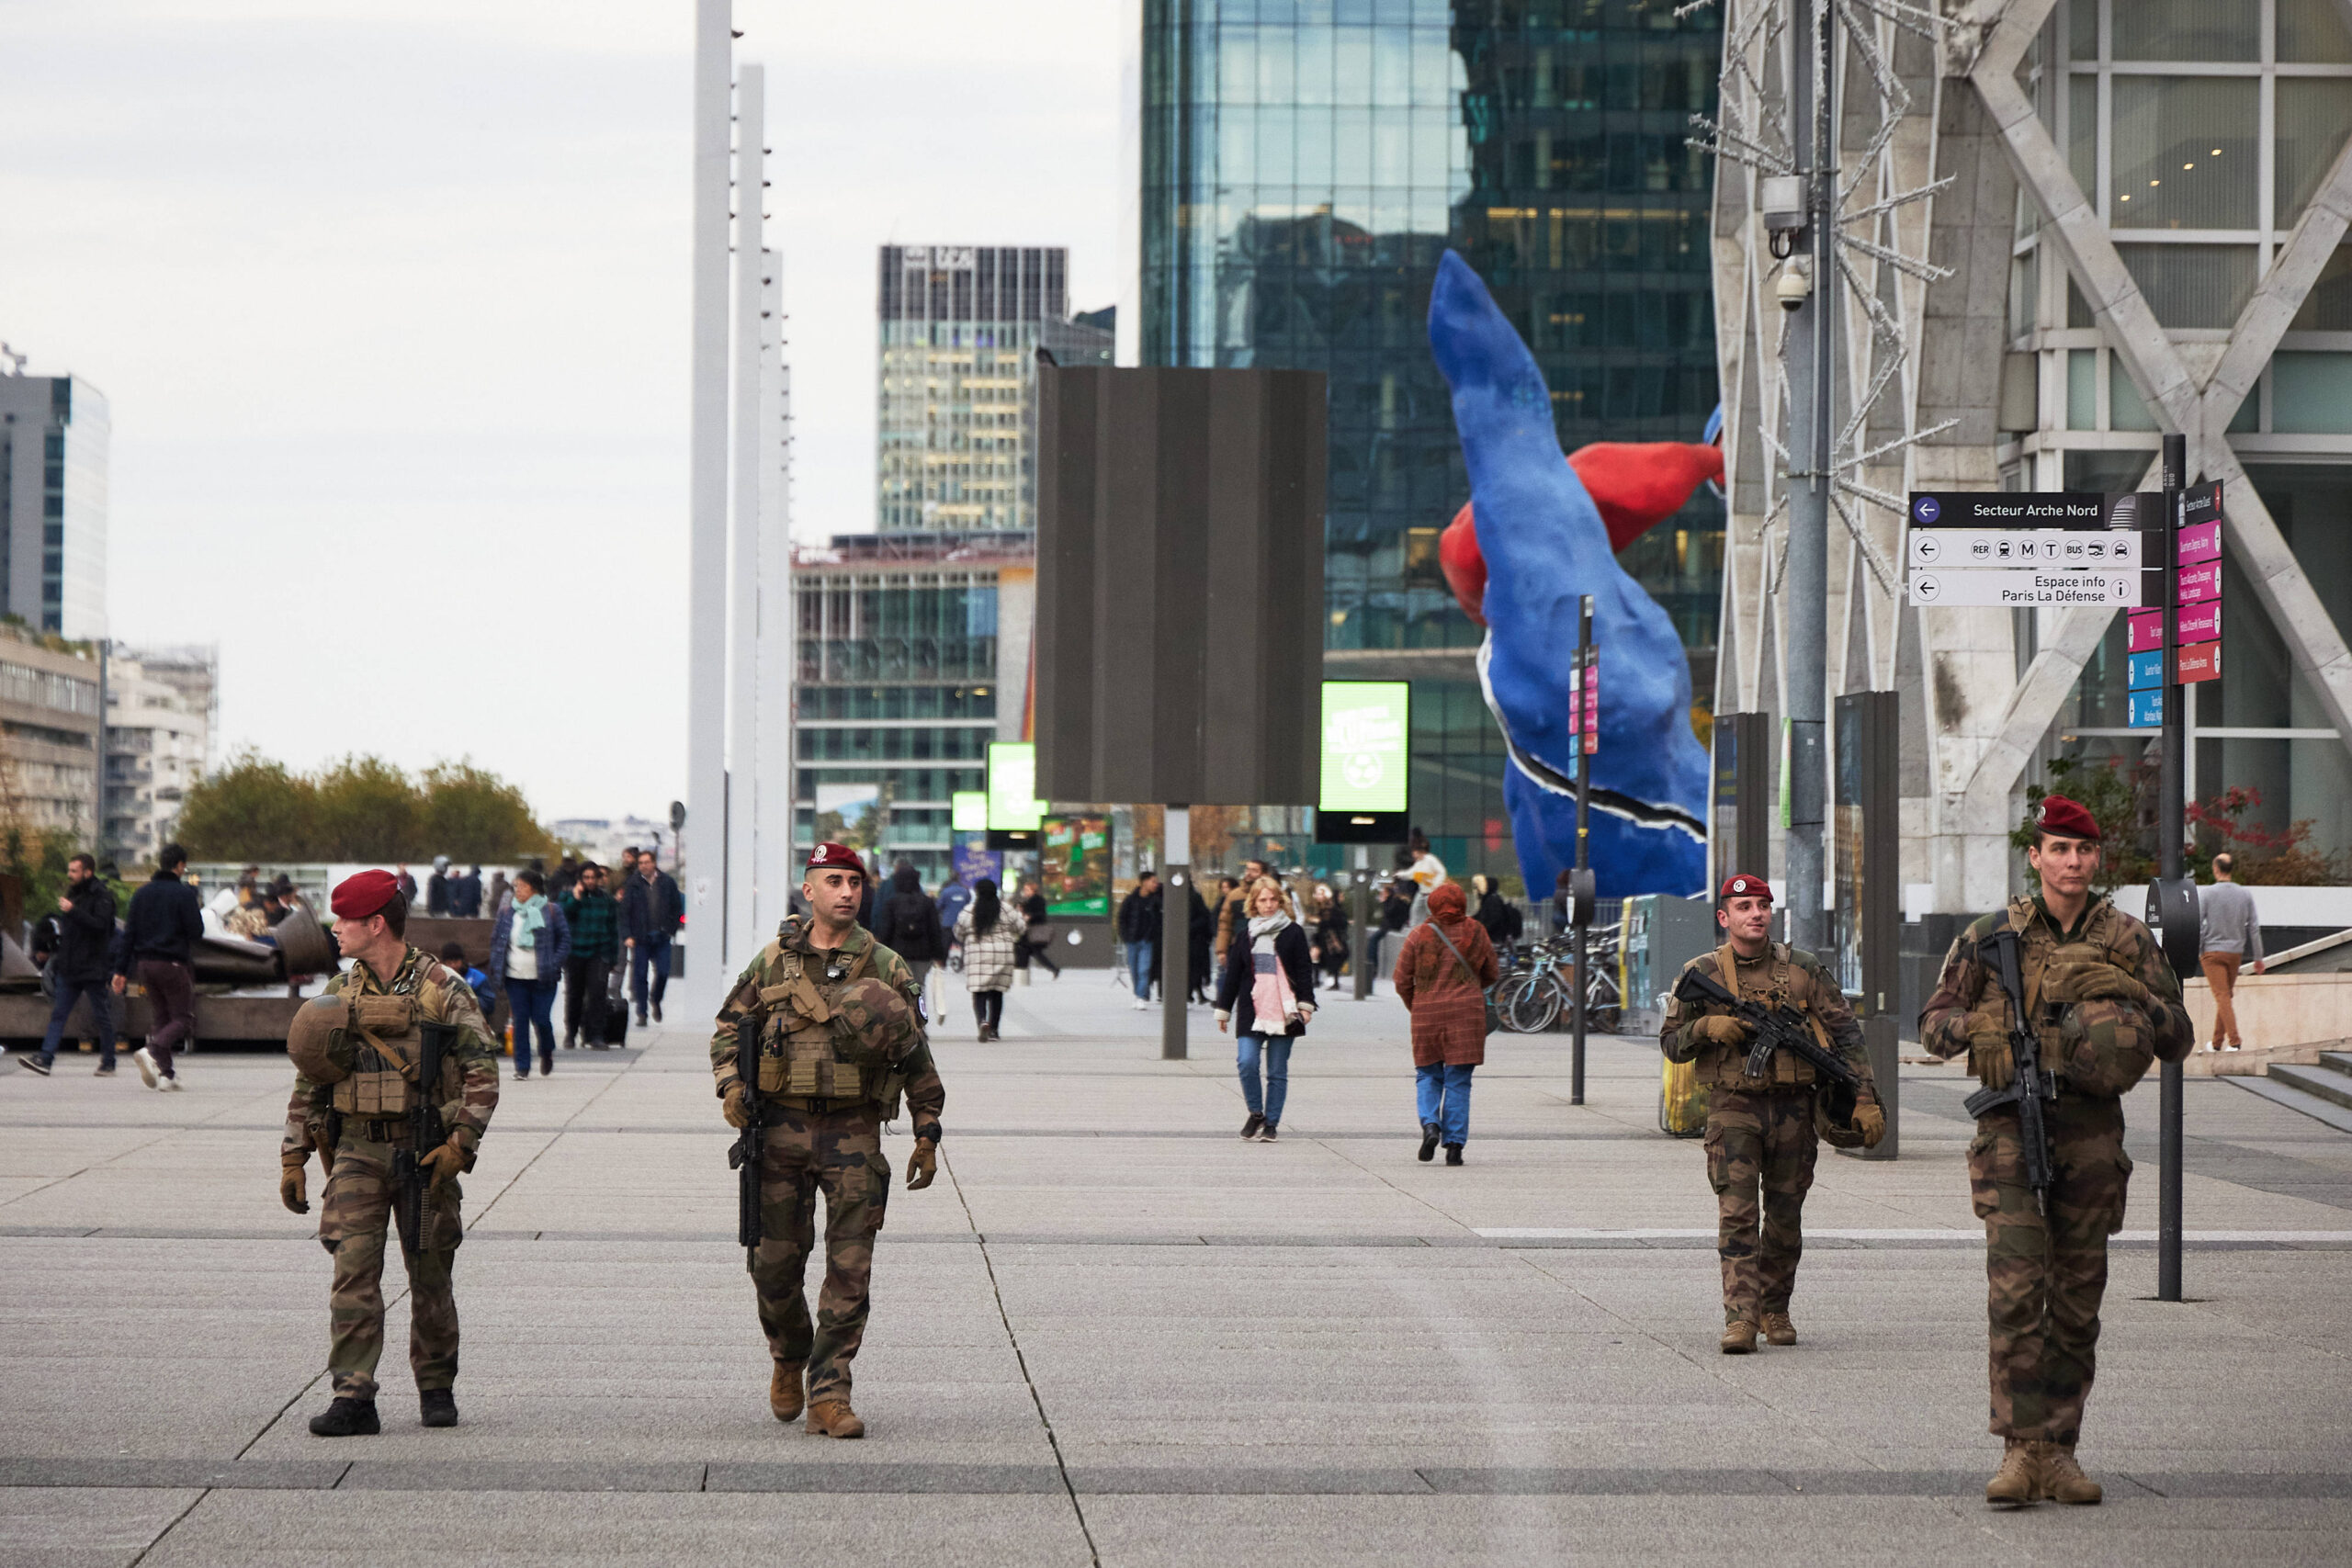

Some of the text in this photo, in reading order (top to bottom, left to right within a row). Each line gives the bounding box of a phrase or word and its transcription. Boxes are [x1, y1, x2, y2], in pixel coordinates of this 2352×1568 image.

[1973, 503, 2098, 516] Secteur Arche Nord
[1973, 544, 2083, 556] RER M T BUS
[2035, 576, 2106, 590] Espace info
[2002, 589, 2106, 602] Paris La Défense
